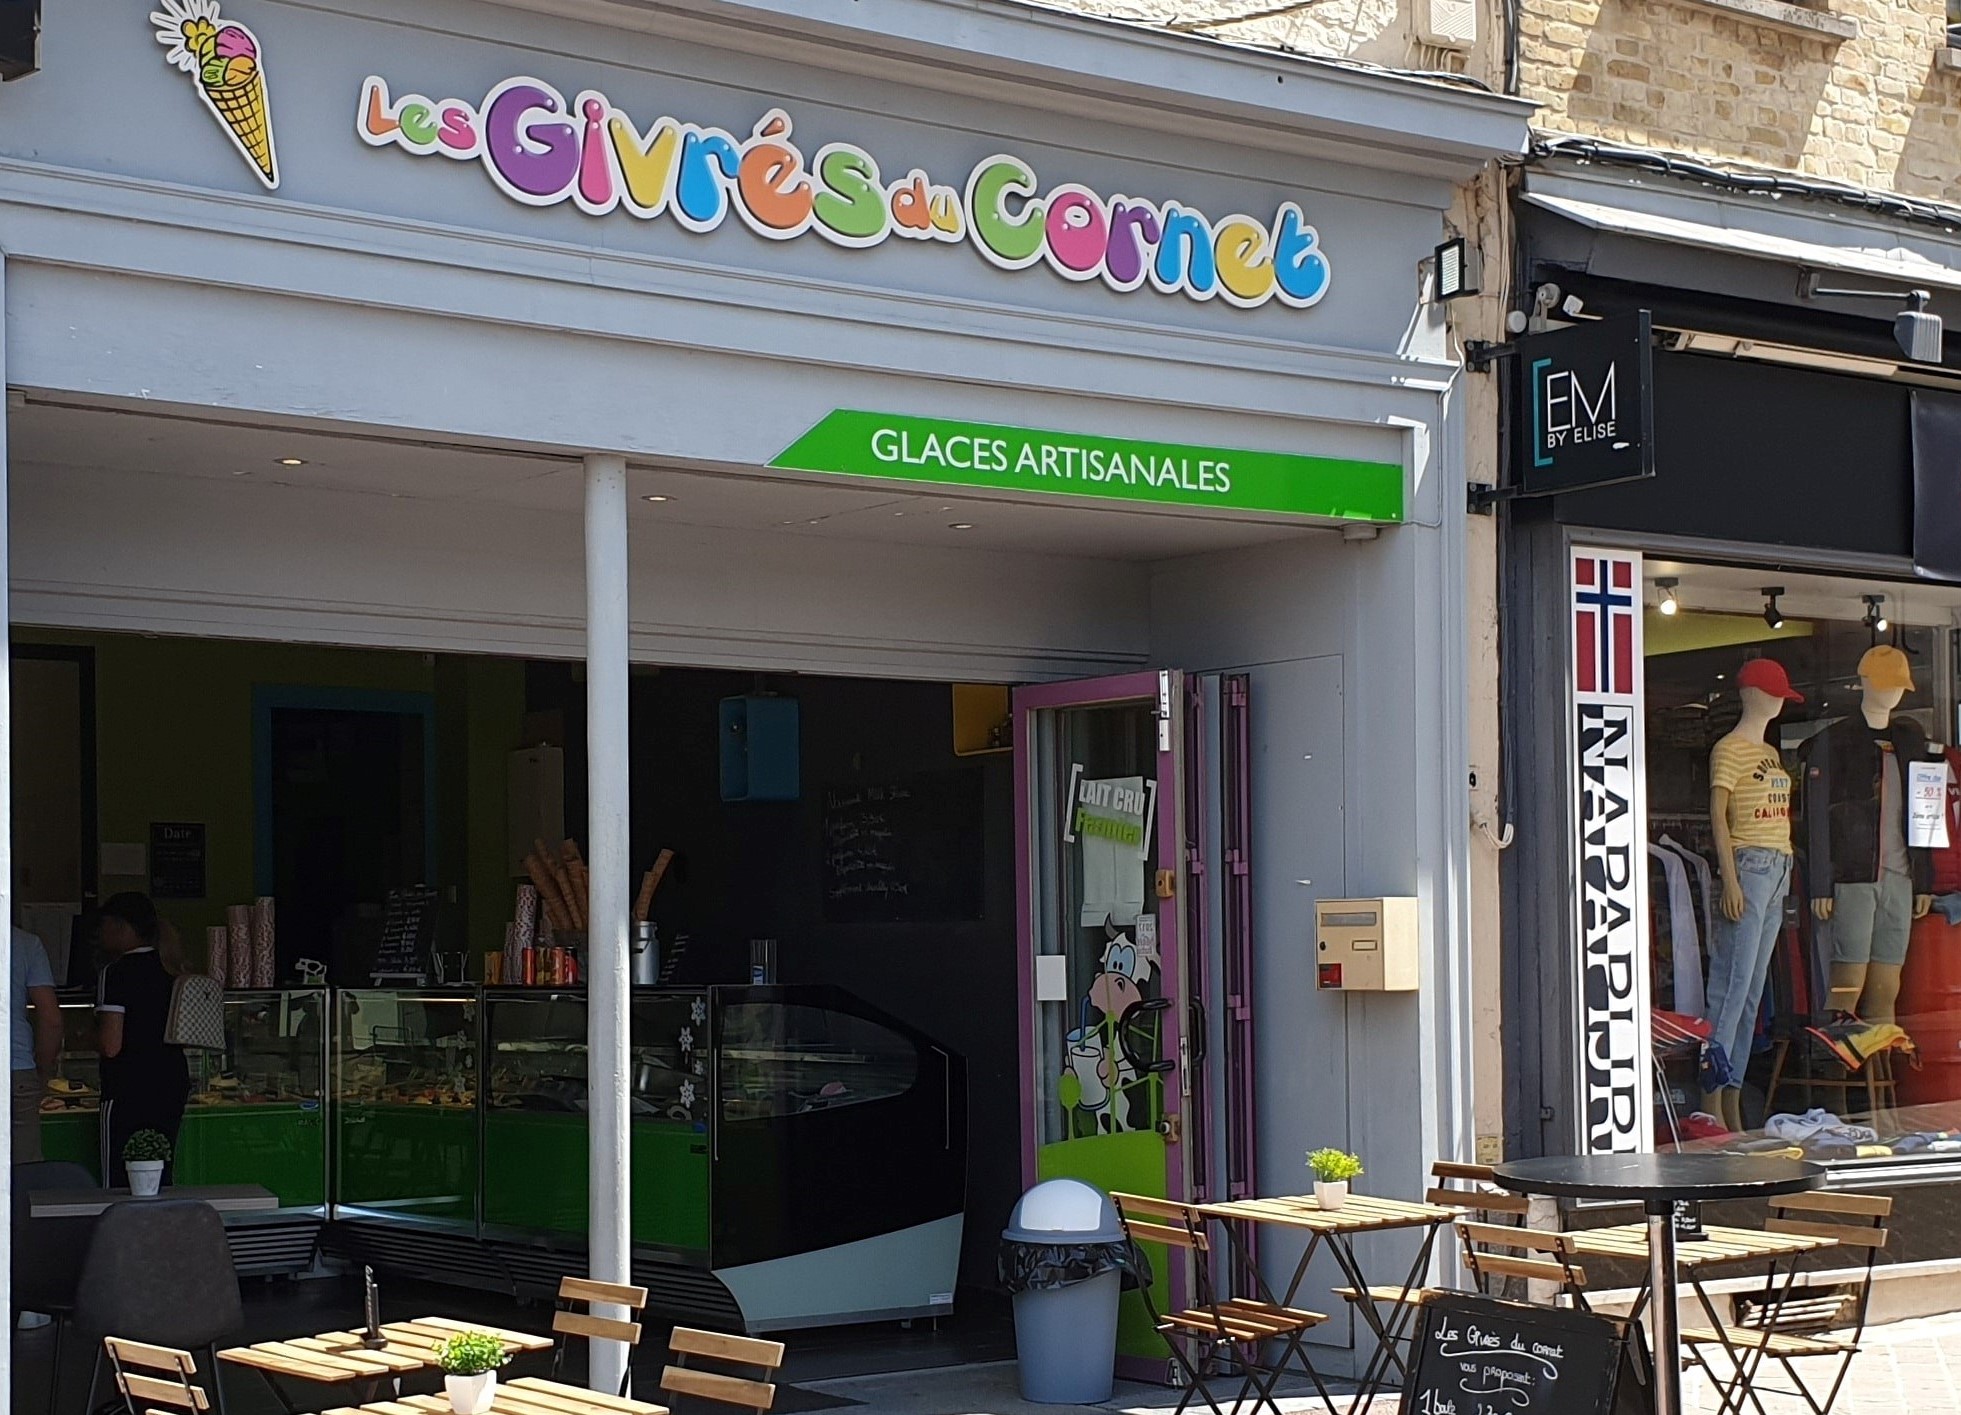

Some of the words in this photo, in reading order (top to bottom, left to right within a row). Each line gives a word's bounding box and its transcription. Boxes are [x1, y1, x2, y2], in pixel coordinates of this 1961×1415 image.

[366, 85, 478, 151] Les
[486, 84, 886, 238] Givrés
[892, 176, 961, 234] du
[972, 162, 1326, 300] Cornet
[1547, 360, 1616, 432] EM
[1547, 431, 1567, 448] BY
[1574, 421, 1616, 443] ELISE
[871, 428, 1008, 472] GLACES
[1014, 442, 1231, 493] ARTISANALES
[1079, 781, 1112, 808] LAIT
[1113, 786, 1146, 816] CRU
[1435, 1316, 1459, 1341] Les
[1510, 1332, 1526, 1351] du
[1419, 1388, 1432, 1415] 1
